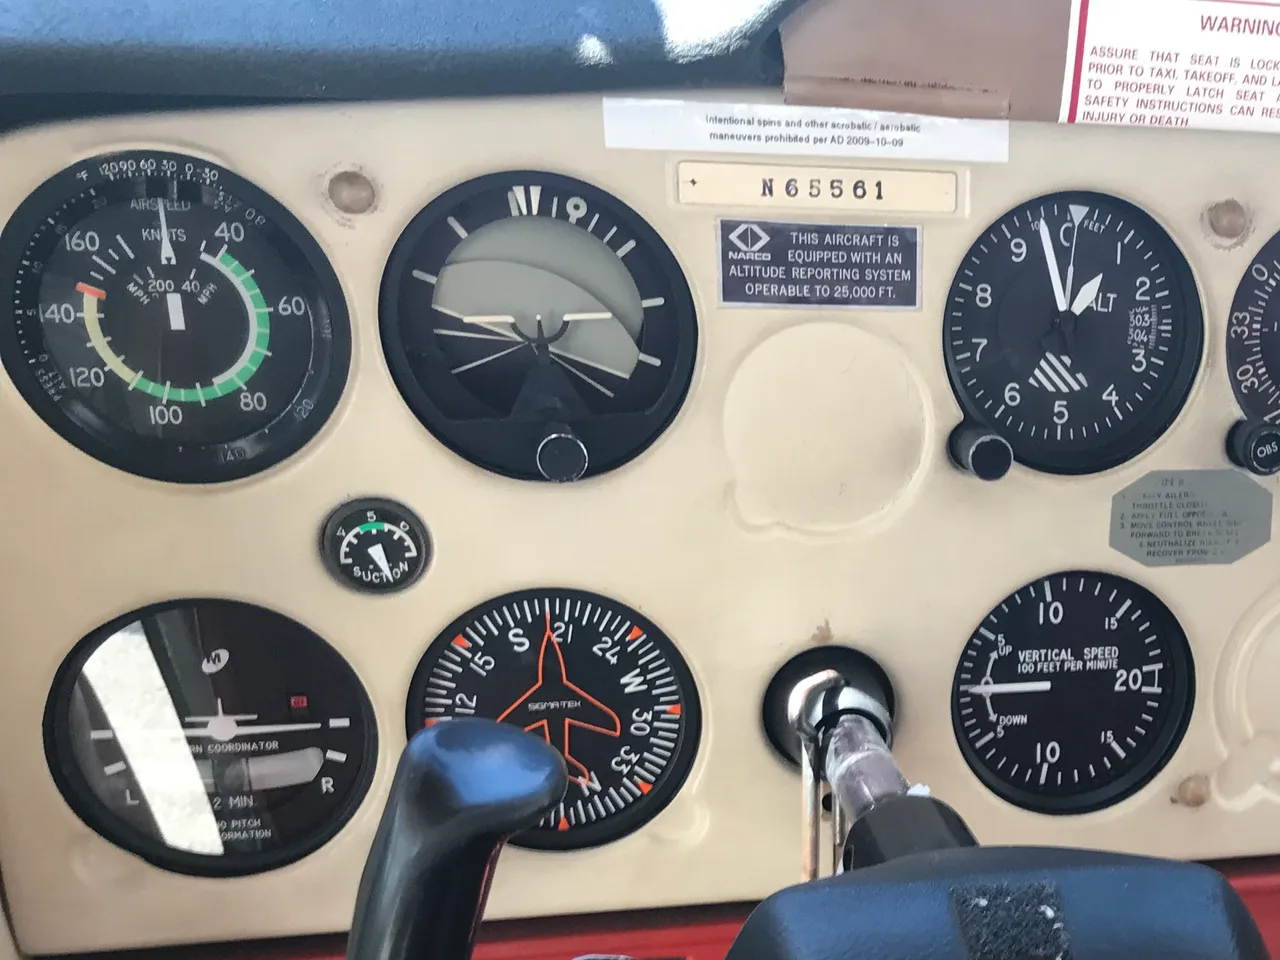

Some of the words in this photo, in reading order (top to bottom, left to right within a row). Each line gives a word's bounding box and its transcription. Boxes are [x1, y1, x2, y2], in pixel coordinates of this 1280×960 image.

[1089, 45, 1139, 60] ASSURE
[1149, 50, 1180, 63] THAT
[1190, 54, 1220, 67] SEAT
[1230, 57, 1240, 68] IS
[1087, 61, 1123, 76] PRIOR
[1128, 65, 1144, 77] TO
[1149, 66, 1178, 81] TAXI,
[1184, 69, 1237, 85] TAKEOFF,
[1242, 74, 1267, 86] AND
[1087, 78, 1102, 90] TO
[1114, 80, 1175, 96] PROPERLY
[1186, 85, 1224, 99] LATCH
[1235, 89, 1265, 102] SEAT
[1084, 94, 1129, 108] SAFETY
[1136, 98, 1223, 115] INSTRUCTIONS
[1230, 105, 1255, 117] CAN
[705, 113, 754, 126] Intentional
[757, 118, 782, 129] spins
[784, 118, 802, 128] and
[804, 119, 829, 129] other
[831, 120, 873, 131] acrobatic
[880, 122, 921, 133] aerobatic
[1082, 110, 1125, 123] INJURY
[1129, 113, 1146, 125] OR
[709, 131, 762, 142] maneuvers
[764, 133, 810, 145] prohibited
[813, 137, 828, 147] per
[830, 135, 844, 145] AD
[846, 136, 904, 148] 2009-10-09
[130, 198, 191, 211] AIRSEED
[65, 231, 100, 252] 160
[141, 228, 187, 242] KNTS
[214, 222, 244, 242] 40
[790, 232, 819, 245] THIS
[824, 233, 884, 247] AIRCRAFT
[888, 235, 899, 247] IS
[728, 251, 771, 261] NARCO
[788, 250, 847, 264] EQUIPPED
[850, 251, 881, 264] WITH
[885, 253, 902, 265] AN
[1010, 237, 1027, 263] 9
[729, 265, 786, 279] ALTITUDE
[792, 266, 860, 281] REPORTING
[865, 268, 911, 281] SYSTEM
[126, 282, 150, 305] MPH
[197, 282, 218, 306] MPH
[745, 283, 811, 297] OPERABLE
[814, 284, 830, 297] TO
[834, 285, 876, 299] 25,000
[879, 286, 896, 299] FT.
[975, 283, 992, 308] 8
[1135, 276, 1151, 301] 2
[39, 303, 75, 324] 140
[278, 296, 306, 316] 60
[1230, 311, 1250, 340] 33
[971, 337, 988, 363] 7
[1131, 348, 1147, 373] 3
[69, 367, 105, 387] 120
[1236, 364, 1260, 394] 30
[240, 392, 267, 411] 80
[1004, 382, 1021, 406] 6
[1102, 383, 1119, 407] 4
[150, 405, 183, 425] 100
[1053, 400, 1069, 424] 5
[1256, 441, 1279, 458] OBS
[353, 560, 409, 584] SUCTON
[1038, 601, 1064, 625] 10
[1105, 617, 1118, 630] 15
[507, 627, 530, 652] S
[553, 622, 574, 644] 21
[592, 636, 621, 666] 24
[998, 644, 1013, 657] UP
[1018, 647, 1075, 663] VERTICAL
[1083, 646, 1119, 660] SPEED
[469, 651, 496, 677] 15
[1017, 662, 1035, 675] 100
[1037, 660, 1061, 673] FEET
[1064, 660, 1083, 672] PER
[1086, 658, 1119, 671] MINUTE
[619, 668, 649, 695] W
[1114, 668, 1143, 692] 20
[455, 693, 477, 715] 12
[630, 707, 653, 737] 30
[999, 714, 1028, 726] DOWN
[207, 740, 279, 754] COORDINATOR
[1100, 731, 1114, 744] 15
[611, 745, 641, 775] 33
[1035, 741, 1061, 765] 10
[320, 776, 336, 795] R
[213, 796, 222, 811] 2
[231, 818, 261, 829] PITCH
